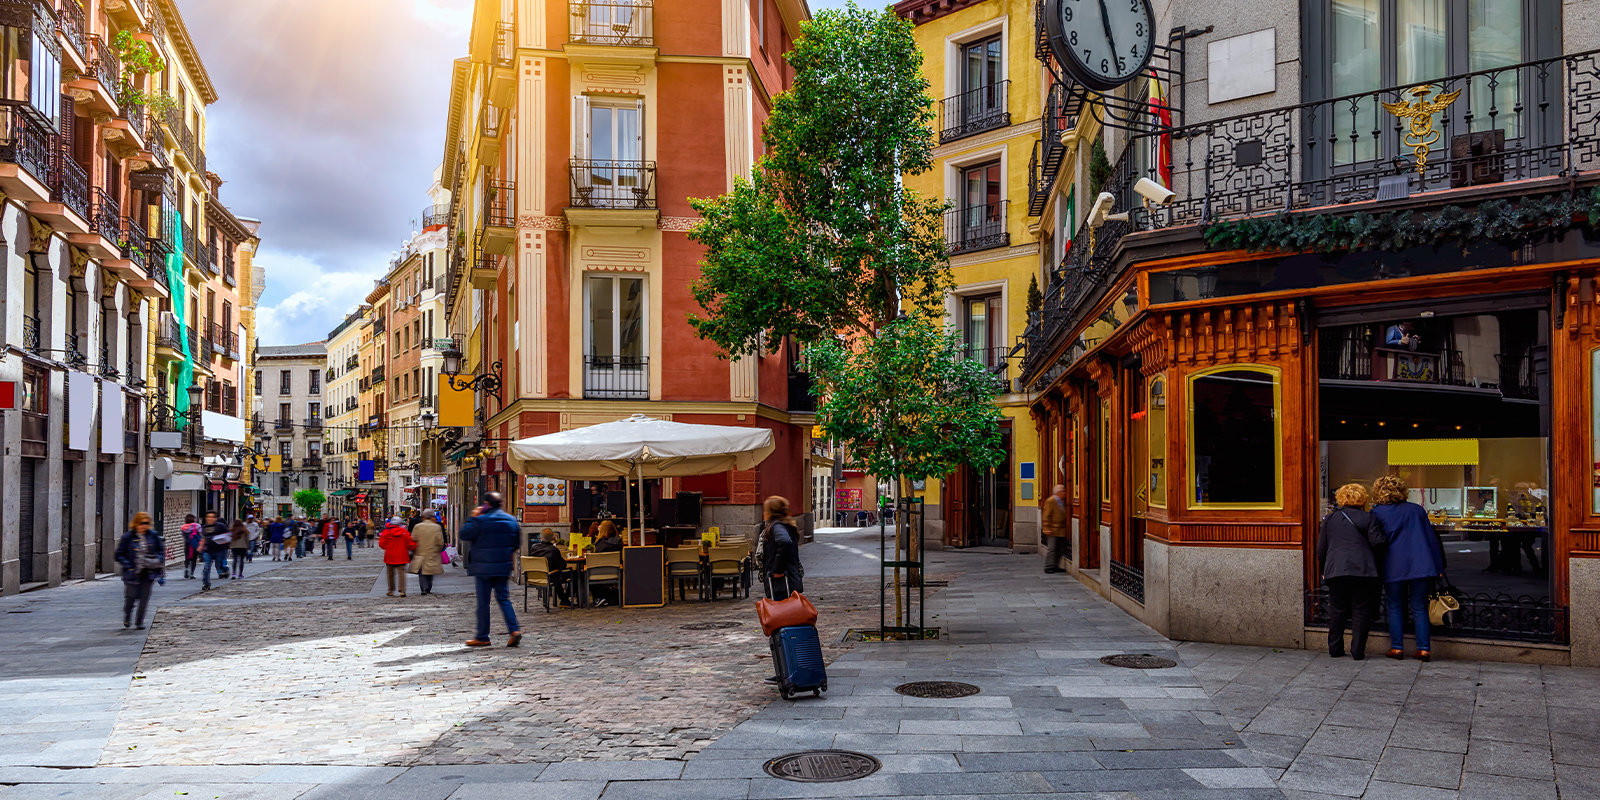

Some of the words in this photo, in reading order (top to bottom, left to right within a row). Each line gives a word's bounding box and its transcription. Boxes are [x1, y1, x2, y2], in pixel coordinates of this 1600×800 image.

[1065, 6, 1073, 22] 9
[1130, 0, 1139, 13] 2
[1135, 22, 1143, 37] 3
[1070, 30, 1078, 46] 8
[1083, 49, 1092, 64] 7
[1130, 43, 1138, 58] 4
[1101, 58, 1109, 74] 6
[1118, 56, 1126, 71] 5
